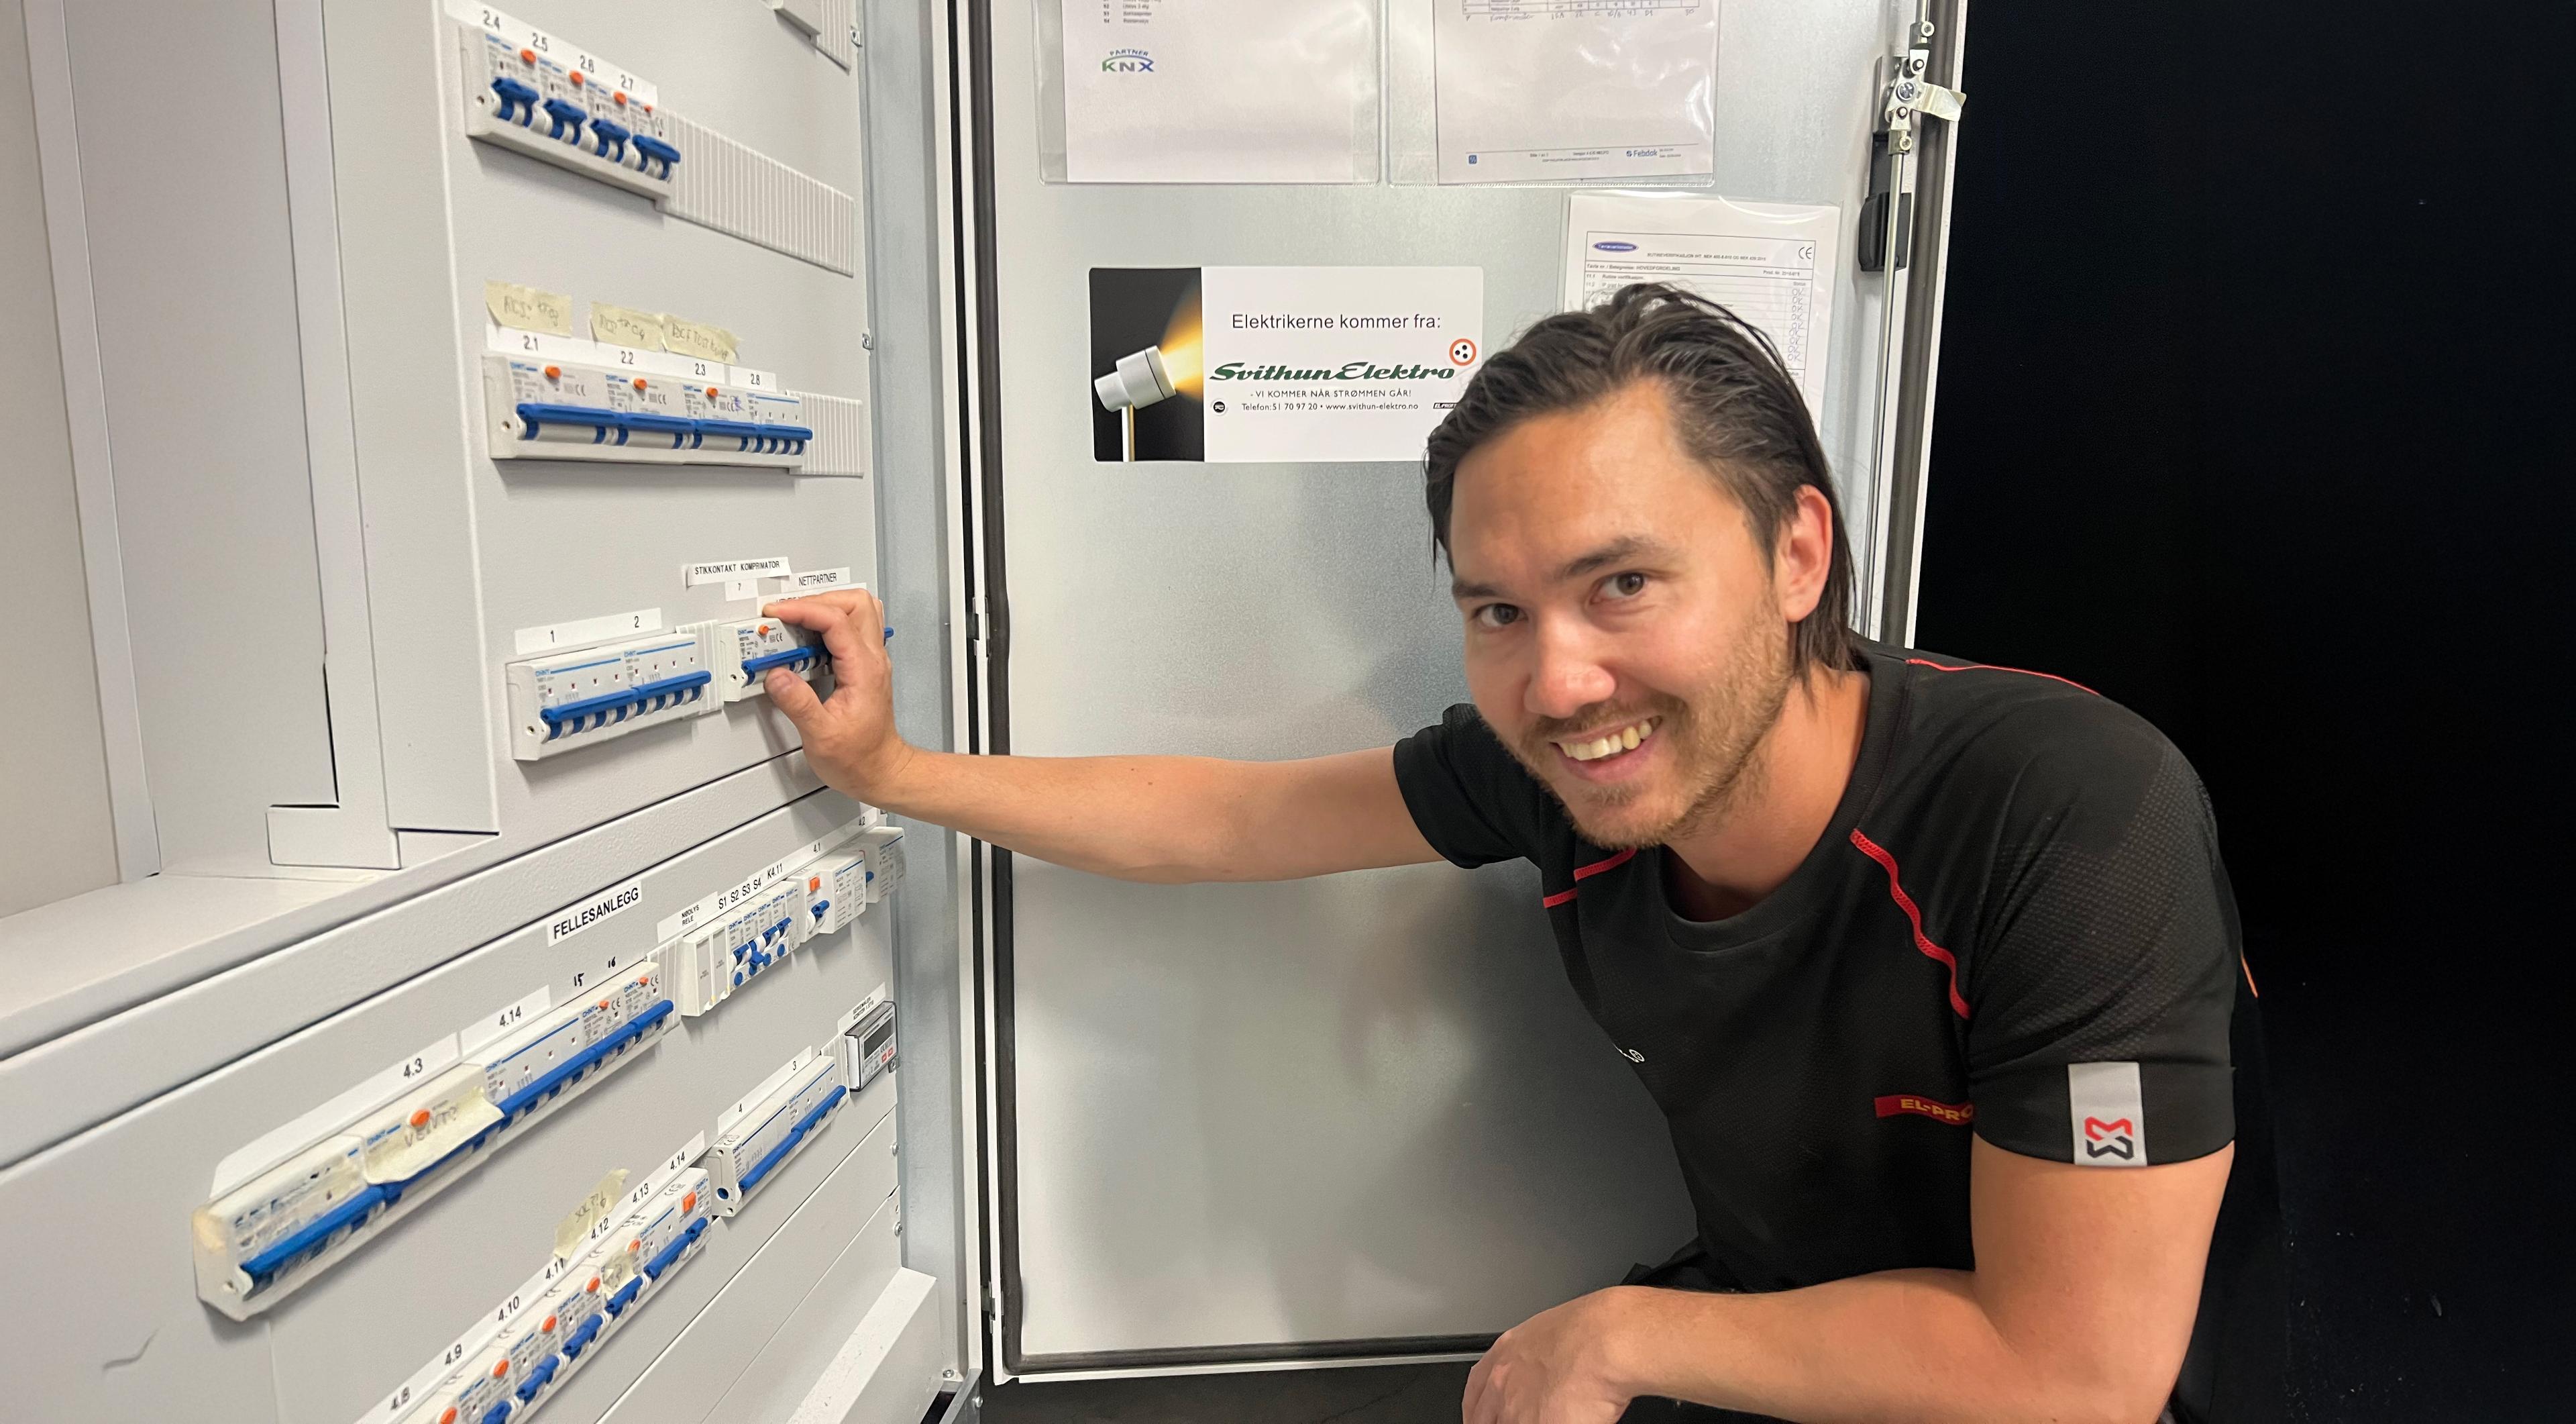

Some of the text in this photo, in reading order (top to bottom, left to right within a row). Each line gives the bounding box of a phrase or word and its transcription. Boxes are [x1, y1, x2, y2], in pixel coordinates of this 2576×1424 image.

[483, 10, 500, 31] 2.4
[532, 32, 548, 52] 2.5
[1110, 48, 1148, 56] PARTNER
[580, 55, 595, 73] 2.6
[1102, 61, 1155, 72] KNX
[621, 74, 633, 92] 2.7
[1633, 149, 1658, 157] Febdok
[1232, 313, 1441, 329] Elektrikerne kommer fra:
[523, 335, 539, 351] 2.1
[621, 350, 634, 365] 2.2
[695, 363, 706, 376] 2.3
[751, 374, 761, 386] 2.8
[1268, 390, 1307, 398] KOMMER
[1310, 388, 1330, 398] NÅR
[1334, 389, 1385, 397] STRØMMEN
[1389, 388, 1411, 397] GÅR!
[694, 560, 780, 575] STIKKONTAKT KOMPRIMATOR
[798, 572, 837, 586] NETTPARTNER
[550, 615, 639, 643] 1 2
[718, 863, 783, 909] S1 S2 S3 S4 K4.11
[553, 887, 639, 939] FELLESANLEGG
[682, 905, 700, 919] NØDLYS
[682, 915, 694, 926] RELE
[608, 956, 616, 968] 16
[499, 1005, 521, 1027] 4.14
[403, 1058, 423, 1078] 4.3
[792, 1060, 797, 1070] 3
[739, 1103, 743, 1113] 4
[670, 1151, 686, 1170] 4.14
[633, 1182, 649, 1203] 4.13
[590, 1217, 609, 1240] 4.12
[545, 1258, 564, 1279] 4.11
[498, 1296, 520, 1321] 4.10
[445, 1343, 462, 1365] 4.9
[390, 1386, 410, 1411] 4.8
